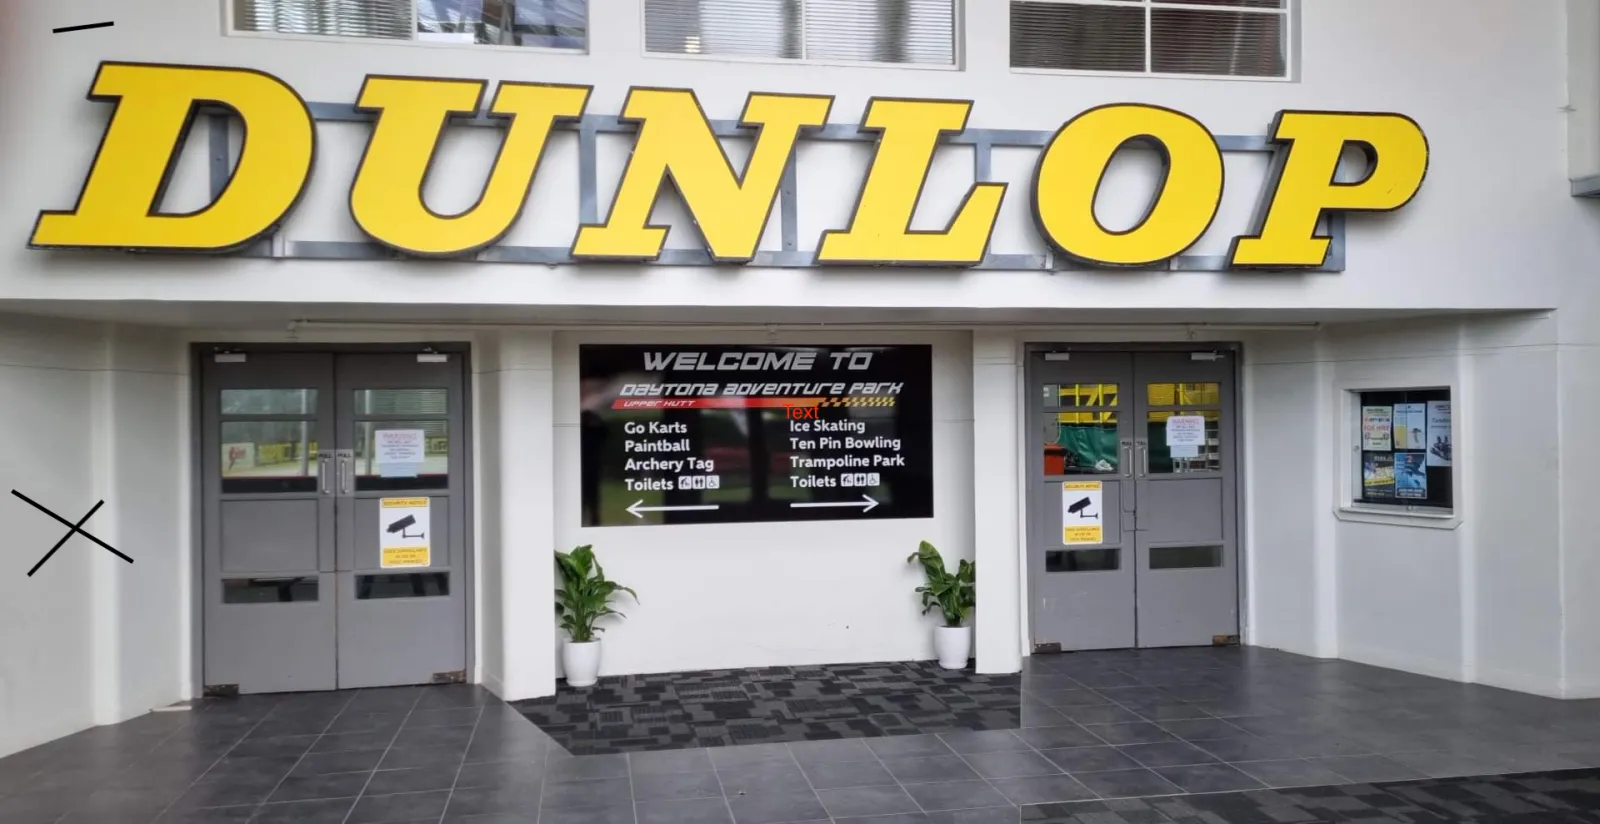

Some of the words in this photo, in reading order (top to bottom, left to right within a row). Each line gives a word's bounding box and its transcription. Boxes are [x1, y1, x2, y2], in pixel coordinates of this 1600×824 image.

[28, 61, 1430, 269] DUNLOP
[643, 350, 816, 372] WELCOME
[830, 352, 874, 371] TO
[624, 421, 645, 435] Go
[649, 421, 688, 435] Karts
[789, 420, 811, 433] Ice
[813, 419, 866, 434] Skating
[624, 438, 691, 454] Paintball
[789, 437, 817, 451] Ten
[819, 436, 843, 450] Pin
[845, 436, 901, 452] Bowling
[624, 457, 684, 474] Archery
[687, 456, 715, 473] Tag
[789, 454, 870, 471] Trampoline
[873, 453, 906, 468] Park
[624, 476, 675, 492] Toilets
[789, 473, 838, 489] Toilets
